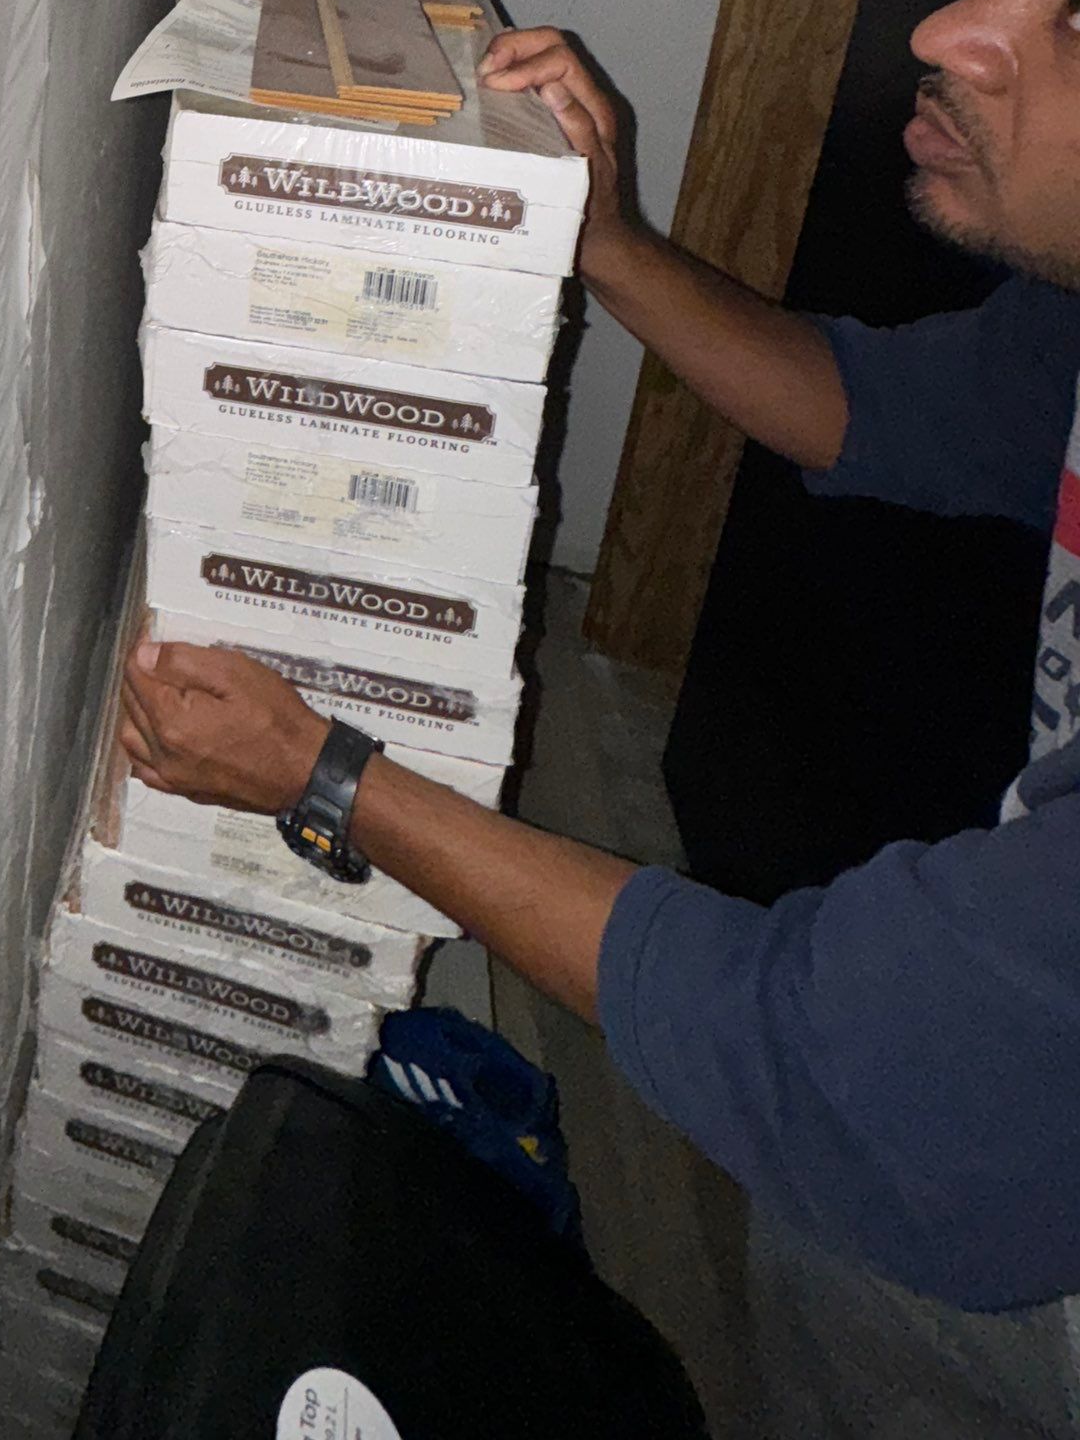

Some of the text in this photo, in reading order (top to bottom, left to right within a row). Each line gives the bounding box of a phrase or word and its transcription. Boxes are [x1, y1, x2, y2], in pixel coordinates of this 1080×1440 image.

[263, 167, 474, 217] WILDWOOD
[234, 199, 313, 219] GLUELESS
[320, 211, 405, 232] LAMINATE
[413, 224, 500, 245] FLOORING
[246, 376, 446, 427] WILDWOOD
[219, 404, 293, 424] GLUELESS
[300, 417, 380, 439] LAMINATE
[388, 432, 470, 454] FLOORING
[215, 590, 286, 612] GLUELESS
[292, 605, 368, 627] LAMINATE
[375, 622, 452, 644] FLOORING
[241, 565, 430, 620] WILDWOOD
[305, 693, 455, 732] AMINATE FLOORING
[126, 955, 290, 1020] WILDWOOD
[112, 1010, 261, 1068] WILWOO
[300, 1388, 321, 1428] Top
